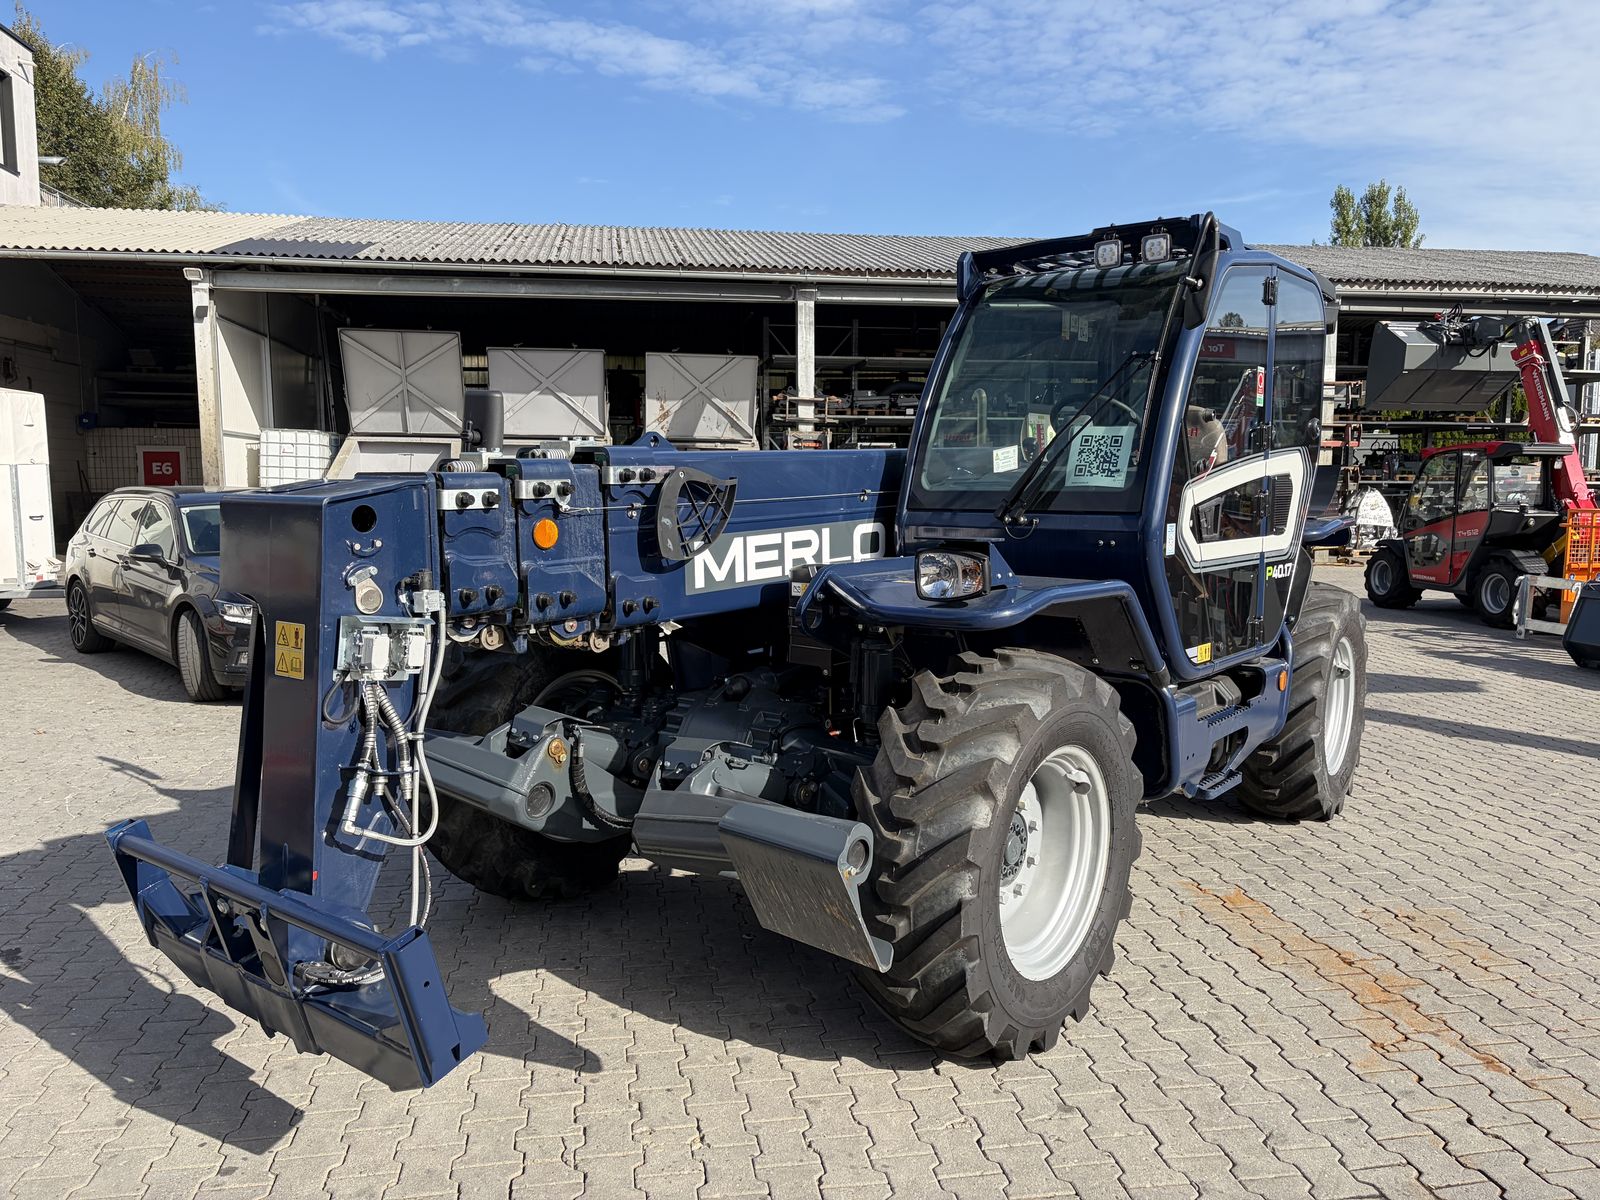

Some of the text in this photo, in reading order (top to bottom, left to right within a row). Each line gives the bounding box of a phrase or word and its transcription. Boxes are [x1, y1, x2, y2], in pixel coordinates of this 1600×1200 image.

[1532, 369, 1551, 421] WEIDEMANN
[151, 462, 173, 475] E6
[1456, 528, 1480, 537] T4512
[693, 522, 886, 589] MERLO
